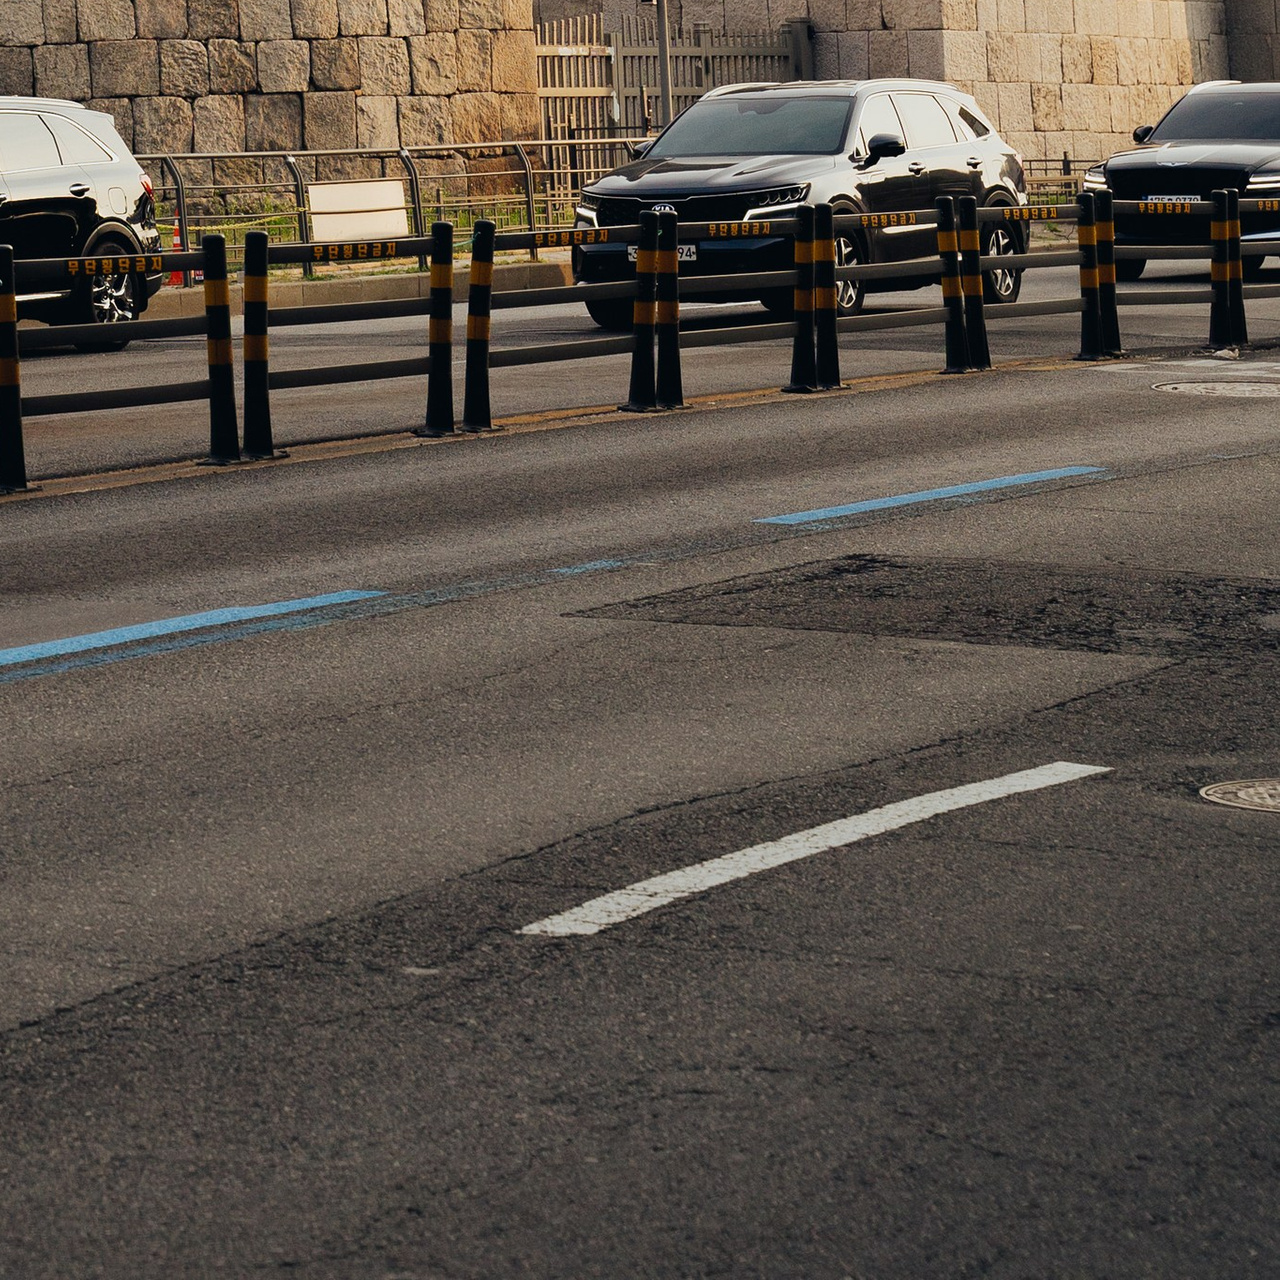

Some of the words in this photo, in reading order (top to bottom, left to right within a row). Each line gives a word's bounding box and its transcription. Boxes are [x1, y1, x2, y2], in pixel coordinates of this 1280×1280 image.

[861, 213, 916, 227] 무단횡단금지
[535, 229, 609, 246] 무단횡단금지
[709, 222, 770, 236] 무단횡단금지
[314, 242, 396, 260] 무단횡단금지
[68, 256, 162, 276] 무단횡단금지
